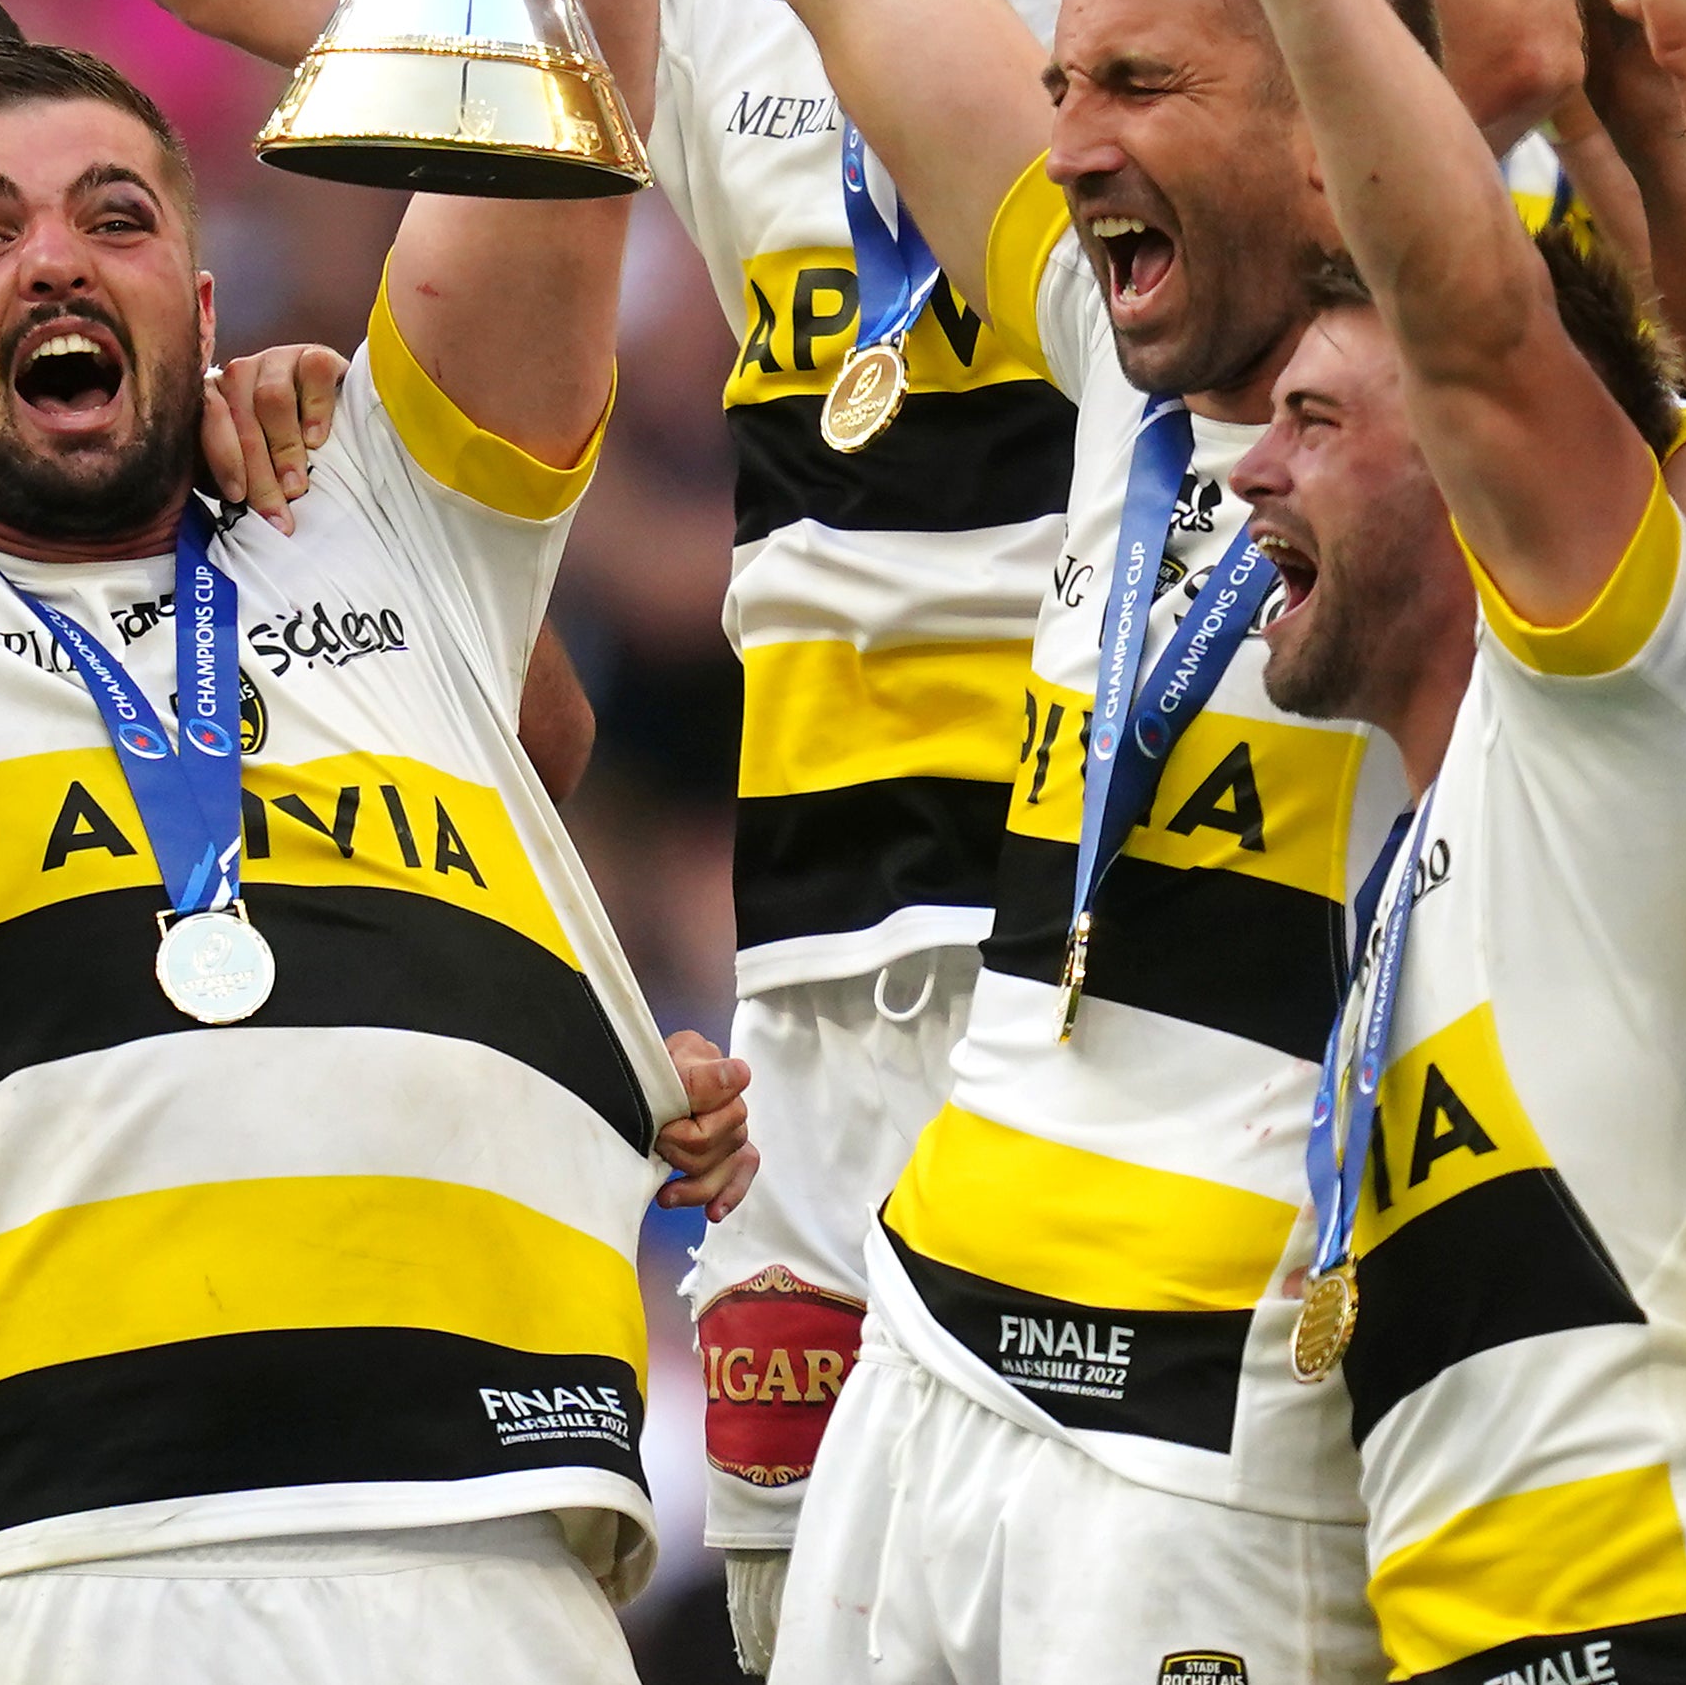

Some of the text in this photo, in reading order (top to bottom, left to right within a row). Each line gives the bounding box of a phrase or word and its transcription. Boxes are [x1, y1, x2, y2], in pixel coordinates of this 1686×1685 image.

[195, 564, 218, 718] CHAMPIONS CUP
[1105, 540, 1147, 720] CHAMPIONS CUP
[1159, 588, 1239, 715] CHAMPIONS
[40, 778, 489, 891] AIVIA
[998, 1314, 1136, 1366] FINALE
[699, 1346, 862, 1403] IGAR
[1083, 1364, 1127, 1386] 2022
[478, 1385, 627, 1421] FINALE
[496, 1413, 630, 1439] MARSEILLE 2022
[1184, 1661, 1222, 1674] STADE
